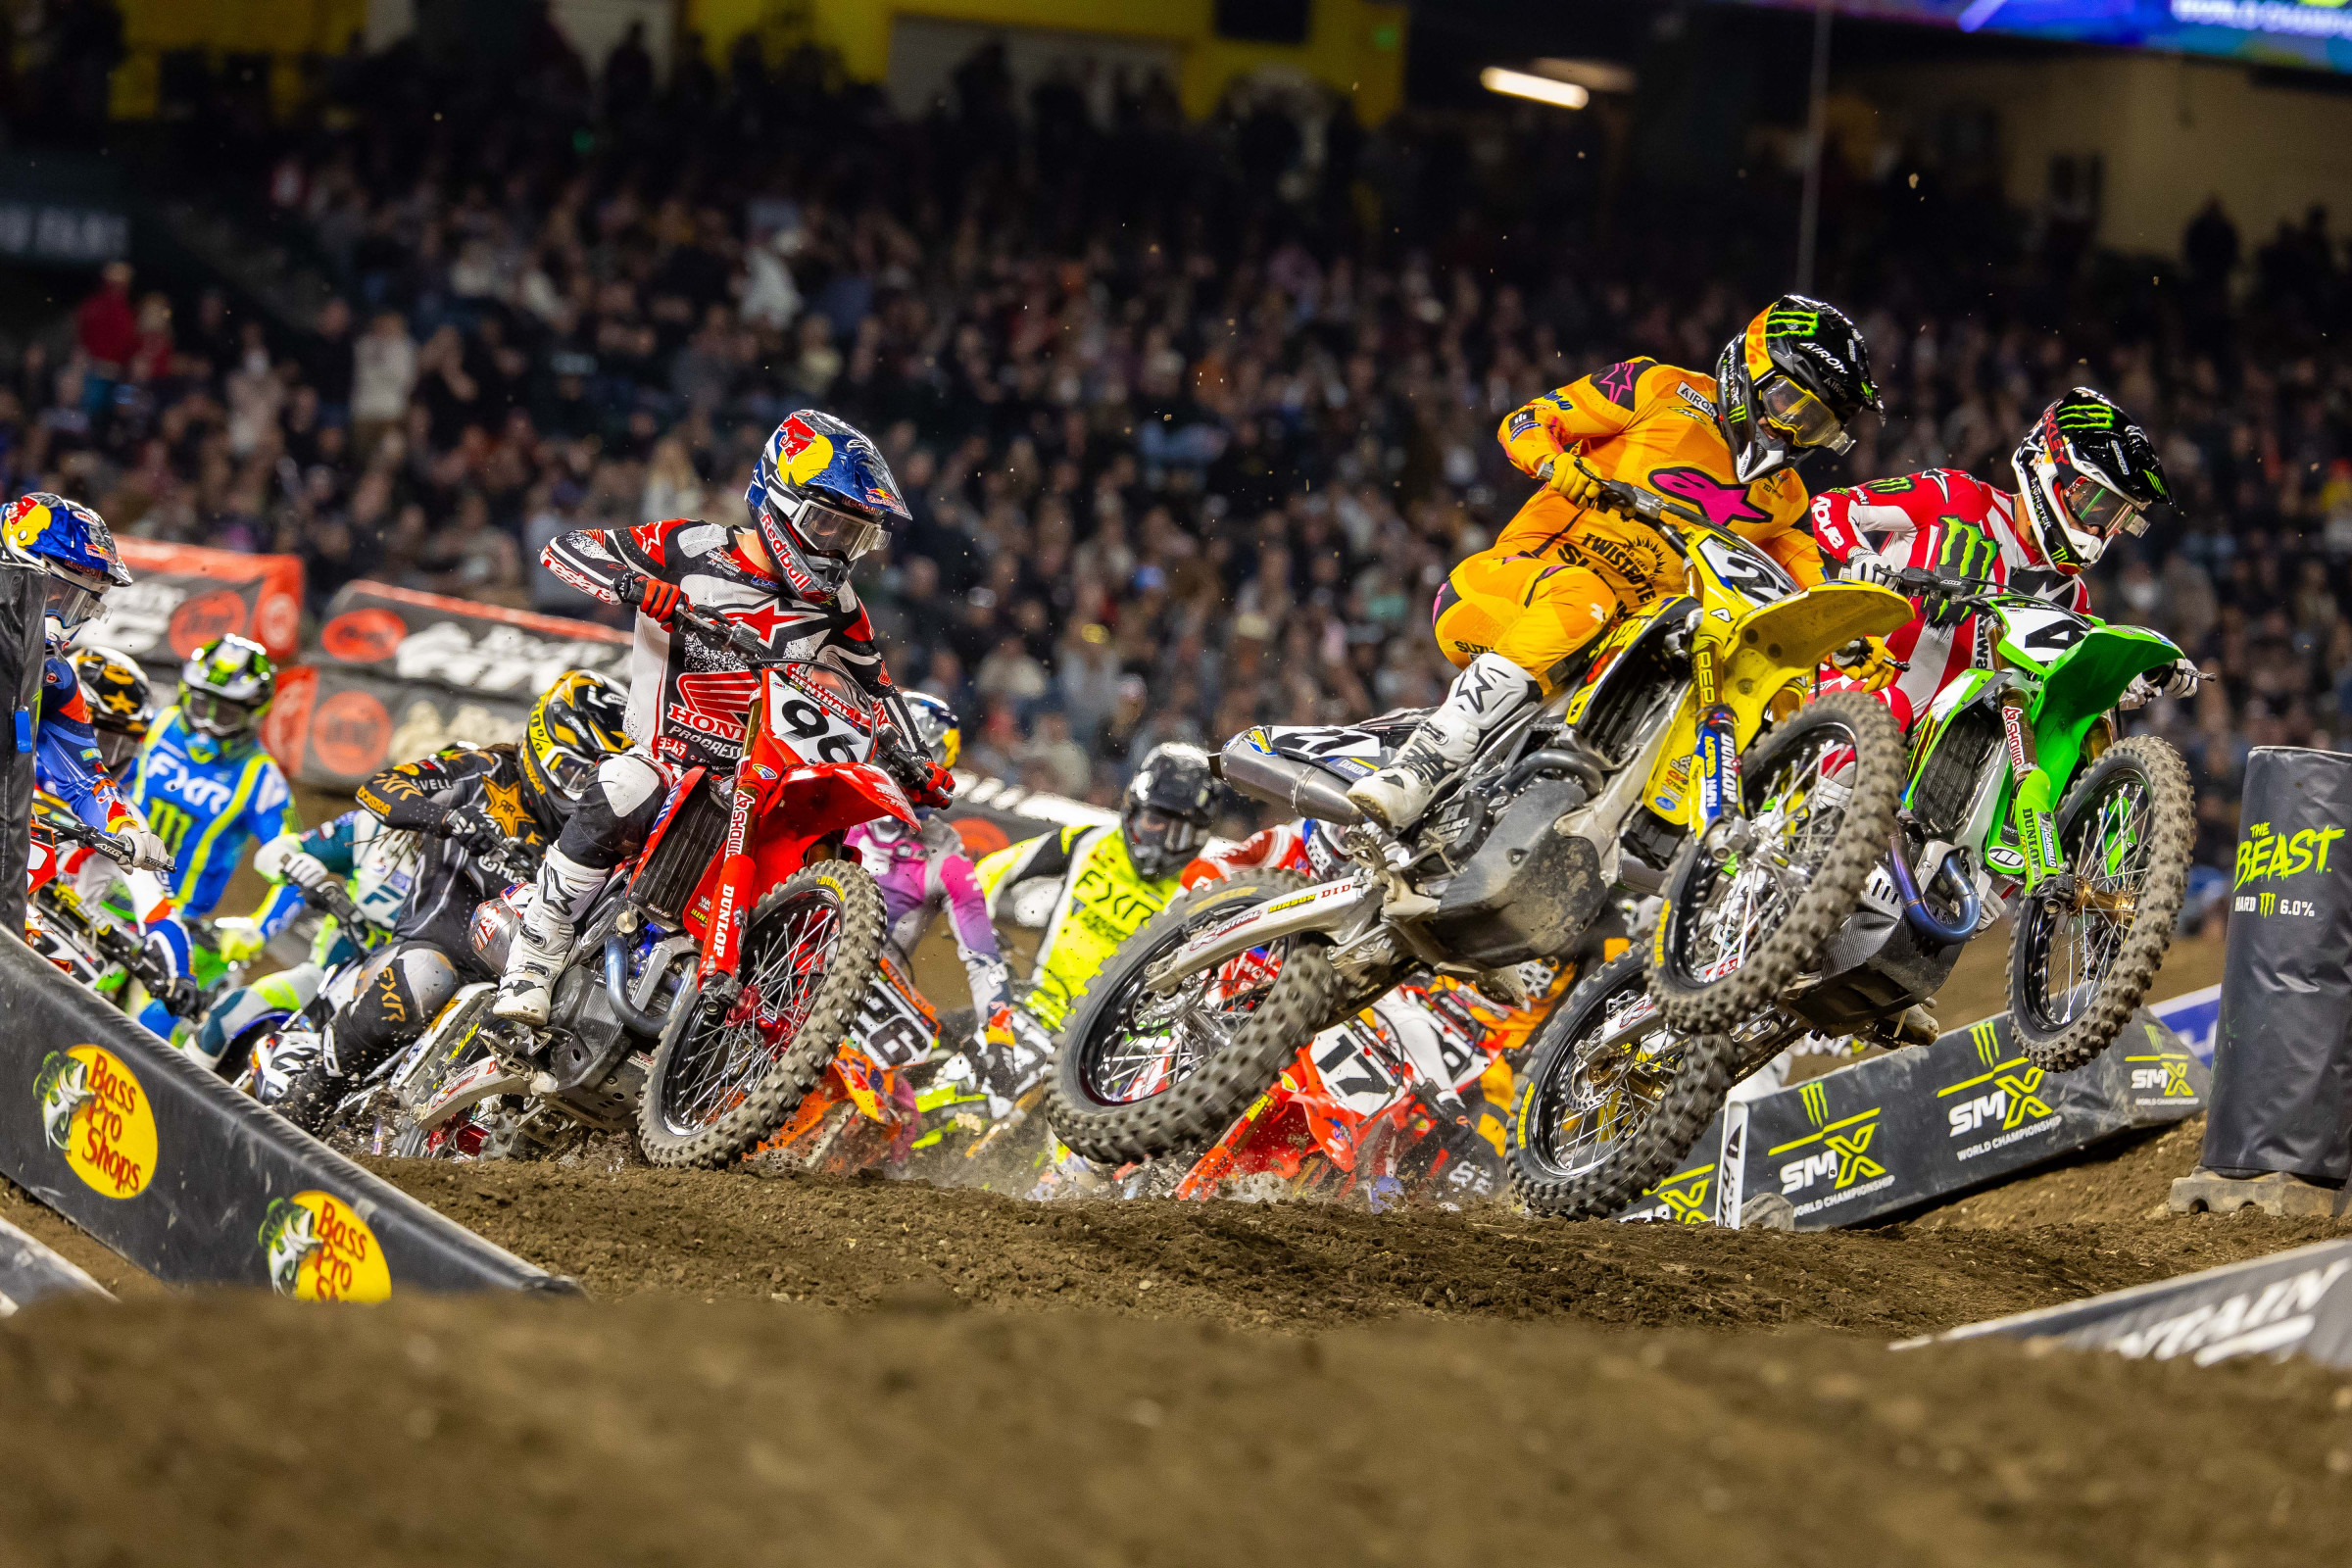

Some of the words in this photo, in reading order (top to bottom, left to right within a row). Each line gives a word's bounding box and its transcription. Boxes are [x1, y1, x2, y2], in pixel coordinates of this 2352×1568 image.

[1636, 581, 1657, 604] TE
[1454, 640, 1494, 654] SUZU
[666, 702, 748, 743] HON
[668, 725, 743, 760] PROGRESS
[782, 700, 858, 763] 96
[146, 753, 231, 814] FXR
[2250, 822, 2270, 838] THE
[2233, 824, 2346, 893] BEAST
[713, 884, 735, 957] DUNLOP
[1267, 894, 1317, 913] HINSON
[2234, 897, 2256, 912] HARD
[2279, 899, 2315, 917] 6.0%
[377, 966, 409, 1023] FXR
[88, 1051, 138, 1114] Bass
[1317, 1034, 1394, 1097] 17
[2131, 1061, 2194, 1097] SMX
[86, 1095, 122, 1142] Pro
[1948, 1067, 2054, 1137] SMX
[82, 1128, 142, 1193] Shops
[1780, 1123, 1886, 1195] SMX
[1957, 1141, 1991, 1161] WORLD
[1991, 1115, 2062, 1149] CHAMPIONSHIP
[1823, 1174, 1895, 1207] CHAMPIONSHIP
[317, 1200, 368, 1261] Bass
[315, 1241, 353, 1291] Pro
